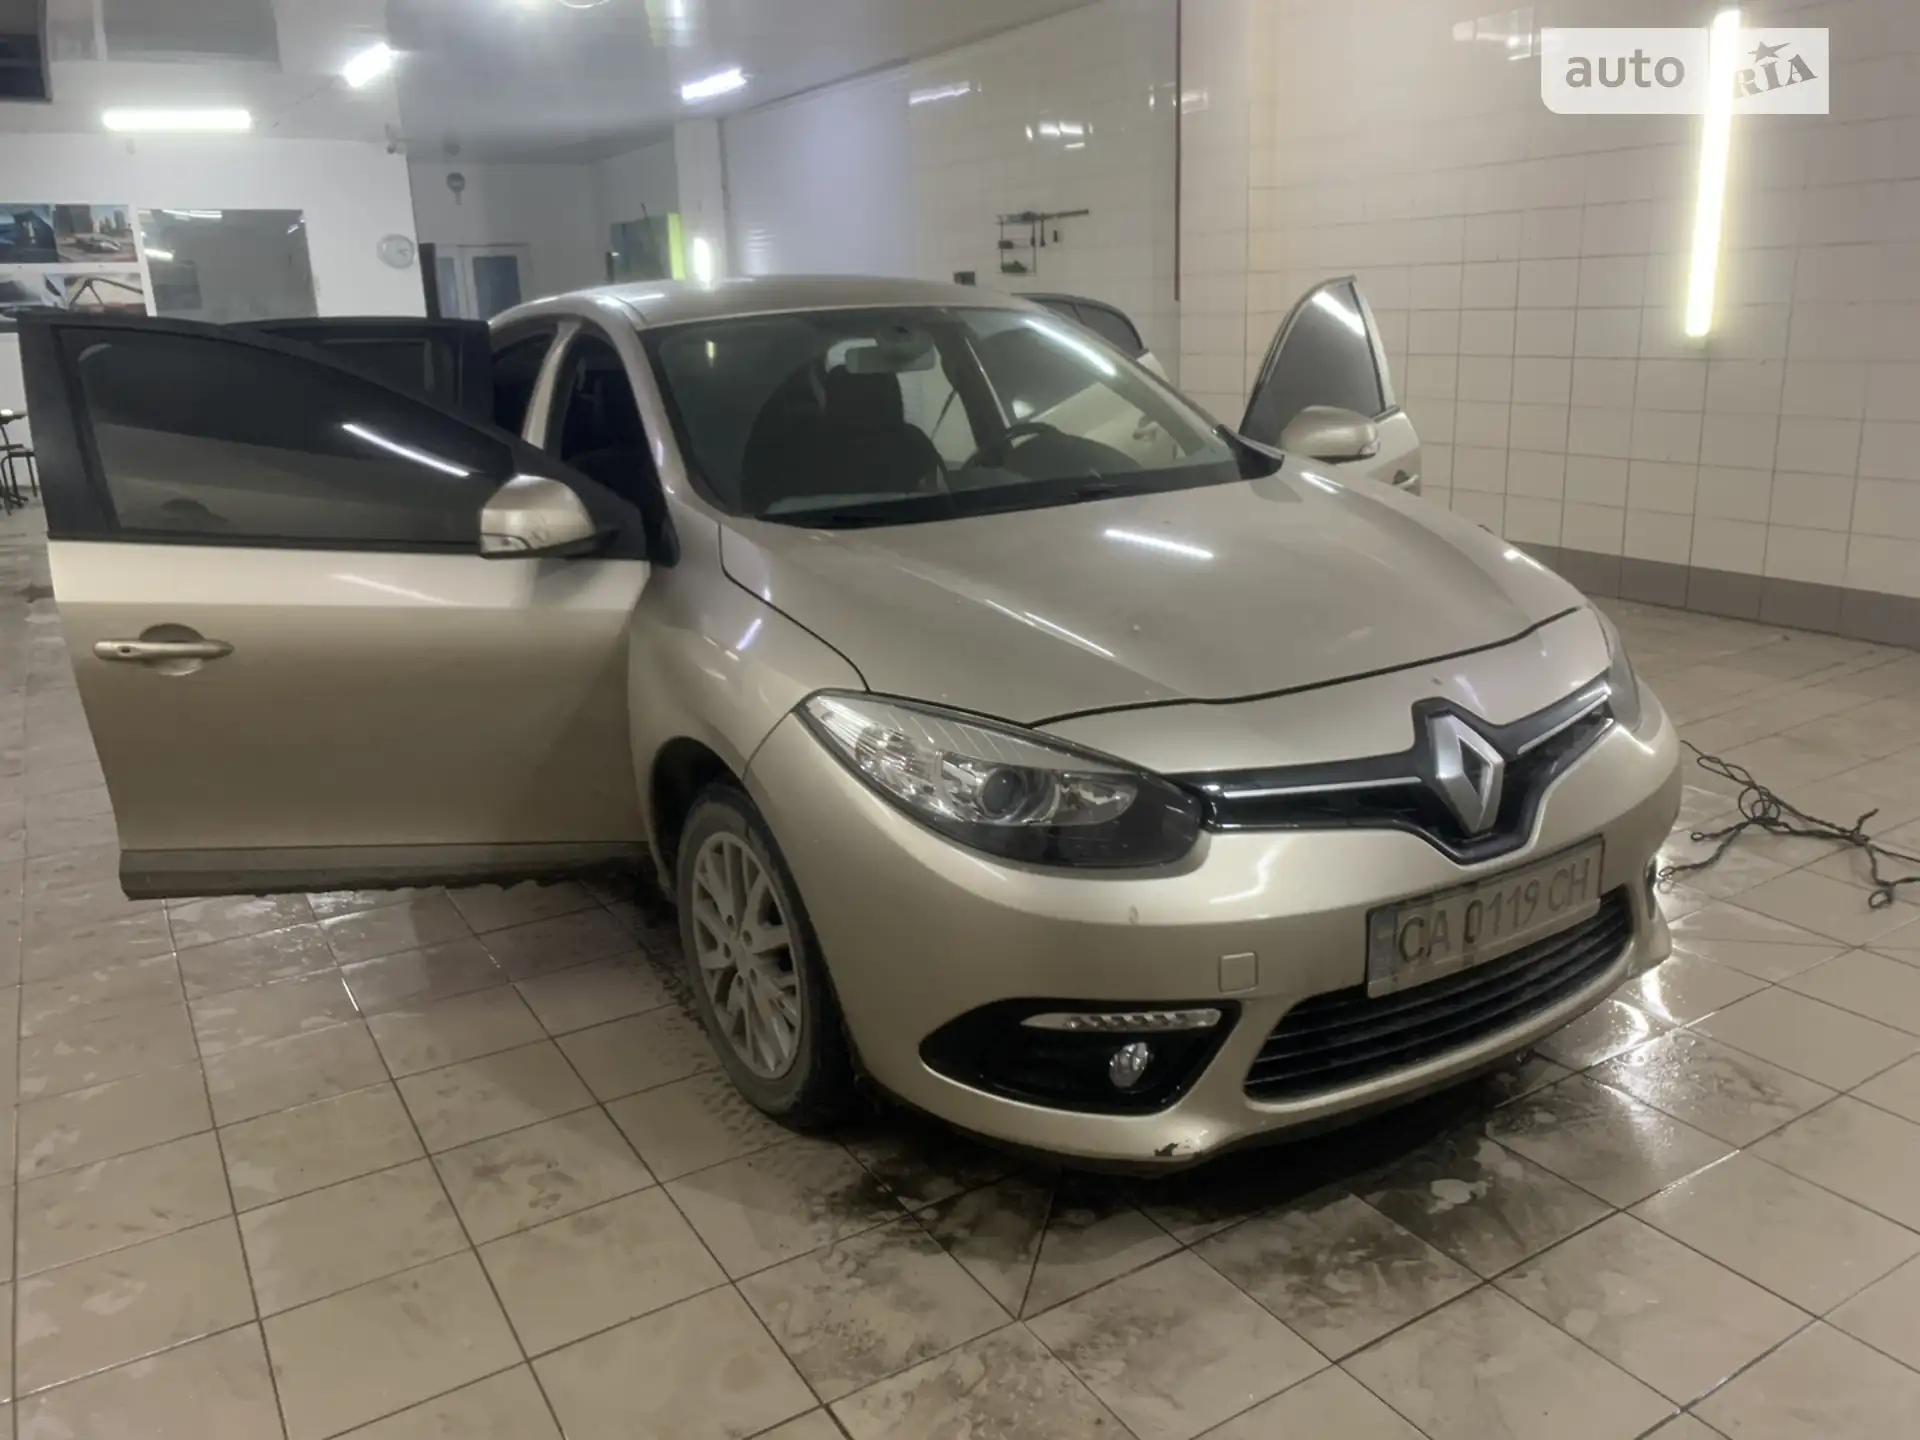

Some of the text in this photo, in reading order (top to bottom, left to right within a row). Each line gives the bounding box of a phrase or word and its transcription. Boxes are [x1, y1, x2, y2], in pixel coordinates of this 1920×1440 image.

[1399, 858, 1590, 963] CA 0119 CH
